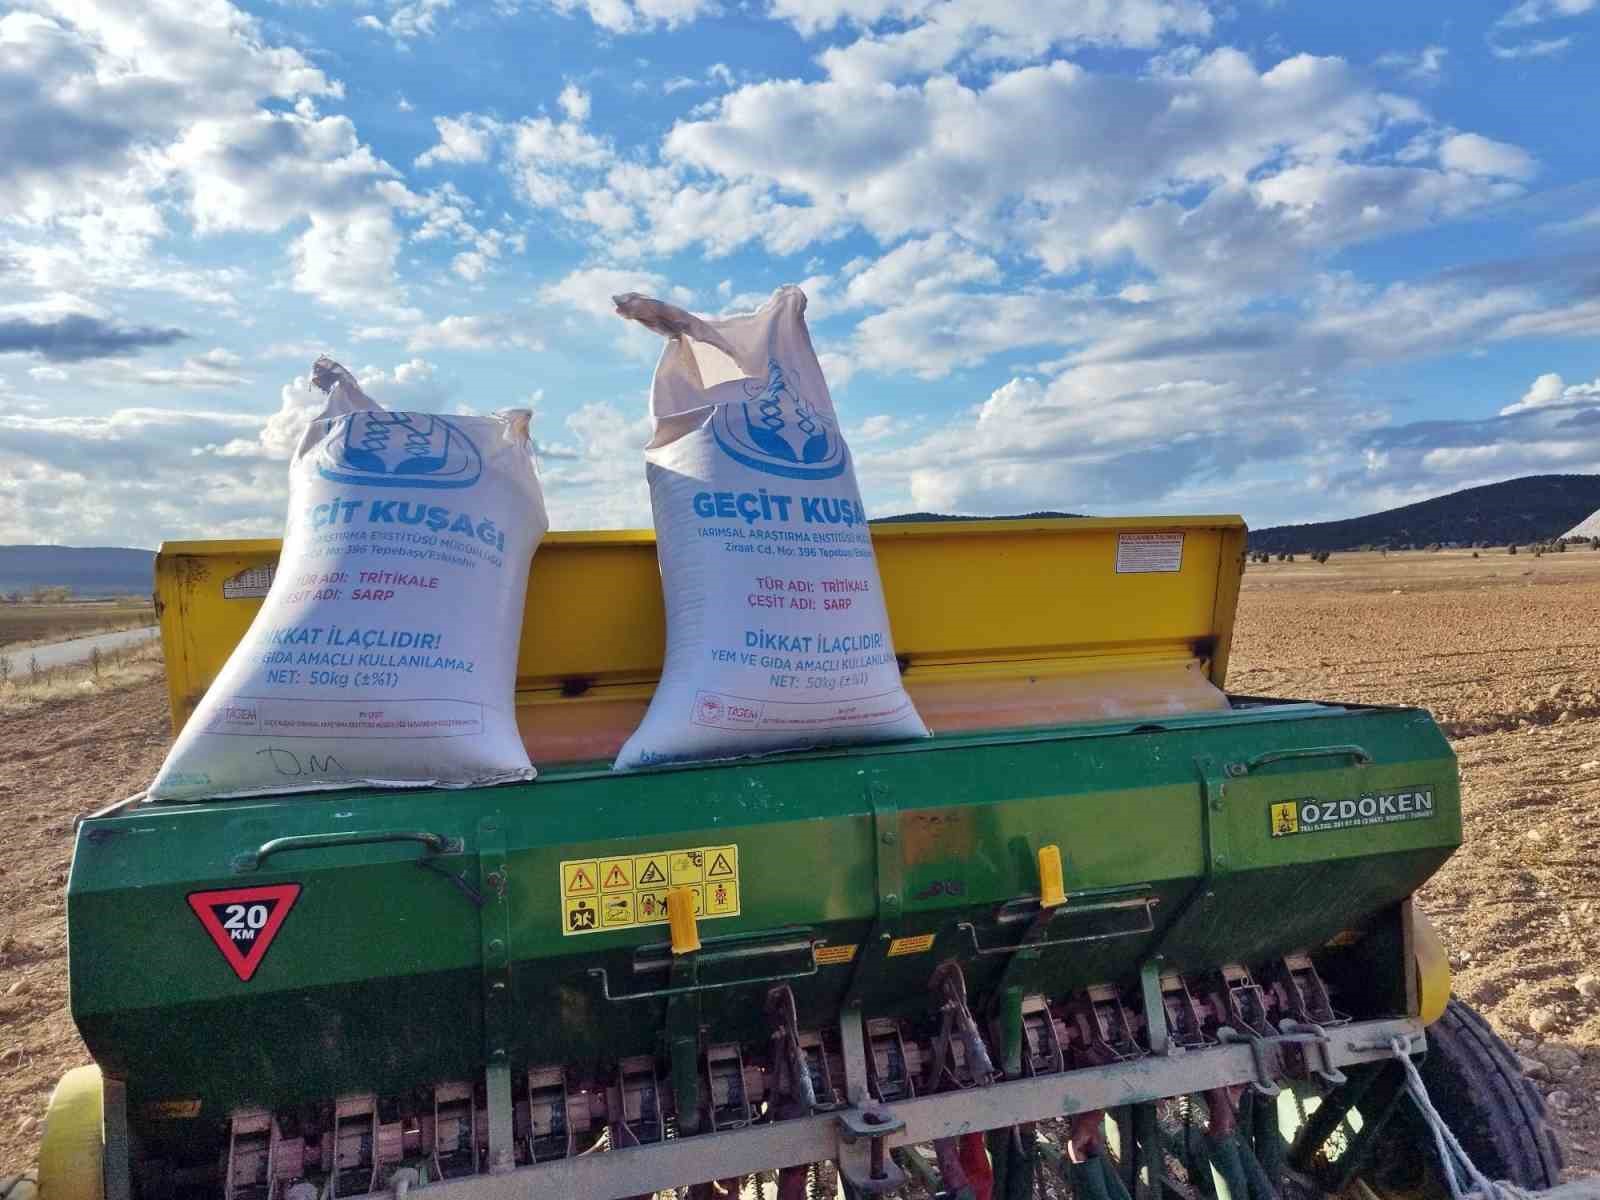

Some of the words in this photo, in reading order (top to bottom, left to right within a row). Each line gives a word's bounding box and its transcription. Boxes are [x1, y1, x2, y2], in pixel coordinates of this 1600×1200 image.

[693, 488, 792, 525] GEÇİT
[800, 496, 866, 529] KUŞA
[367, 499, 506, 553] KUŞAĞI
[698, 527, 746, 539] TARIMSAL
[750, 530, 813, 544] ARAŞTIRMA
[724, 543, 754, 554] Ziraat
[757, 545, 776, 556] Cd.
[777, 547, 795, 557] No:
[799, 548, 817, 558] 396
[318, 571, 349, 585] ADI:
[359, 570, 440, 589] TRİTİKALE
[756, 575, 785, 592] TÜR
[787, 580, 815, 593] ADI:
[821, 578, 871, 593] TRİTİKALE
[313, 588, 342, 601] ADI:
[351, 588, 395, 601] SARP
[747, 593, 786, 610] ÇEŞİT
[789, 598, 816, 610] ADI:
[823, 598, 852, 611] SARP
[327, 625, 443, 651] İLAÇLIDIR!
[745, 625, 813, 653] DİKKAT
[298, 651, 355, 668] AMAÇLI
[358, 653, 475, 674] KULLANILAMAZ
[711, 649, 737, 664] YEM
[740, 652, 758, 666] VE
[760, 657, 792, 671] GIDA
[795, 658, 840, 673] AMAÇLI
[266, 669, 301, 685] NET:
[308, 670, 350, 689] 50kg
[769, 674, 799, 689] NET:
[805, 675, 837, 691] 50kg
[1301, 791, 1432, 823] ÖZDÖKEN
[223, 904, 268, 929] 20
[230, 929, 256, 940] KM
